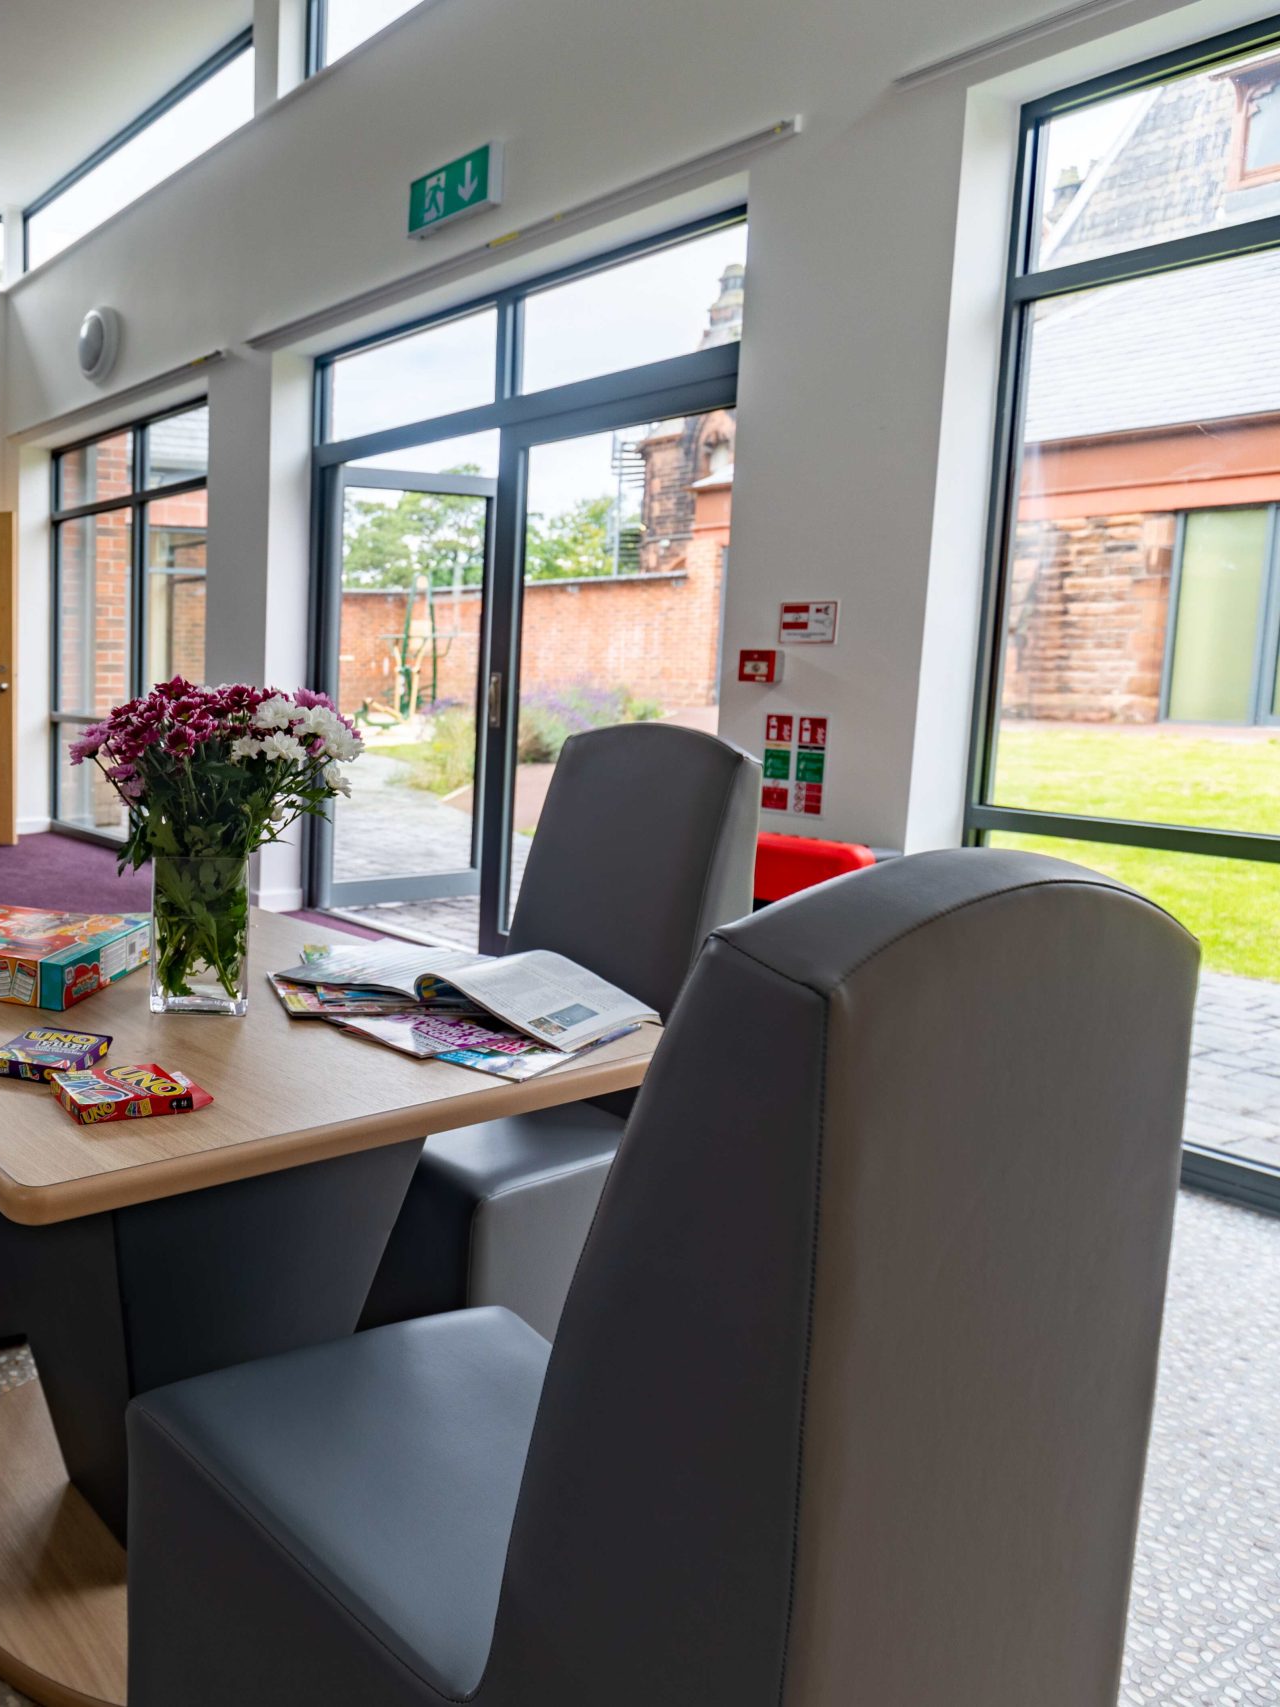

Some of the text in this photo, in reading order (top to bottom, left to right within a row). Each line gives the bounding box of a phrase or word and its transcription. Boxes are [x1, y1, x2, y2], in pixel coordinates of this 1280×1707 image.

[23, 1030, 99, 1045] UNO
[103, 1065, 187, 1097] UNO
[80, 1101, 116, 1124] UNO
